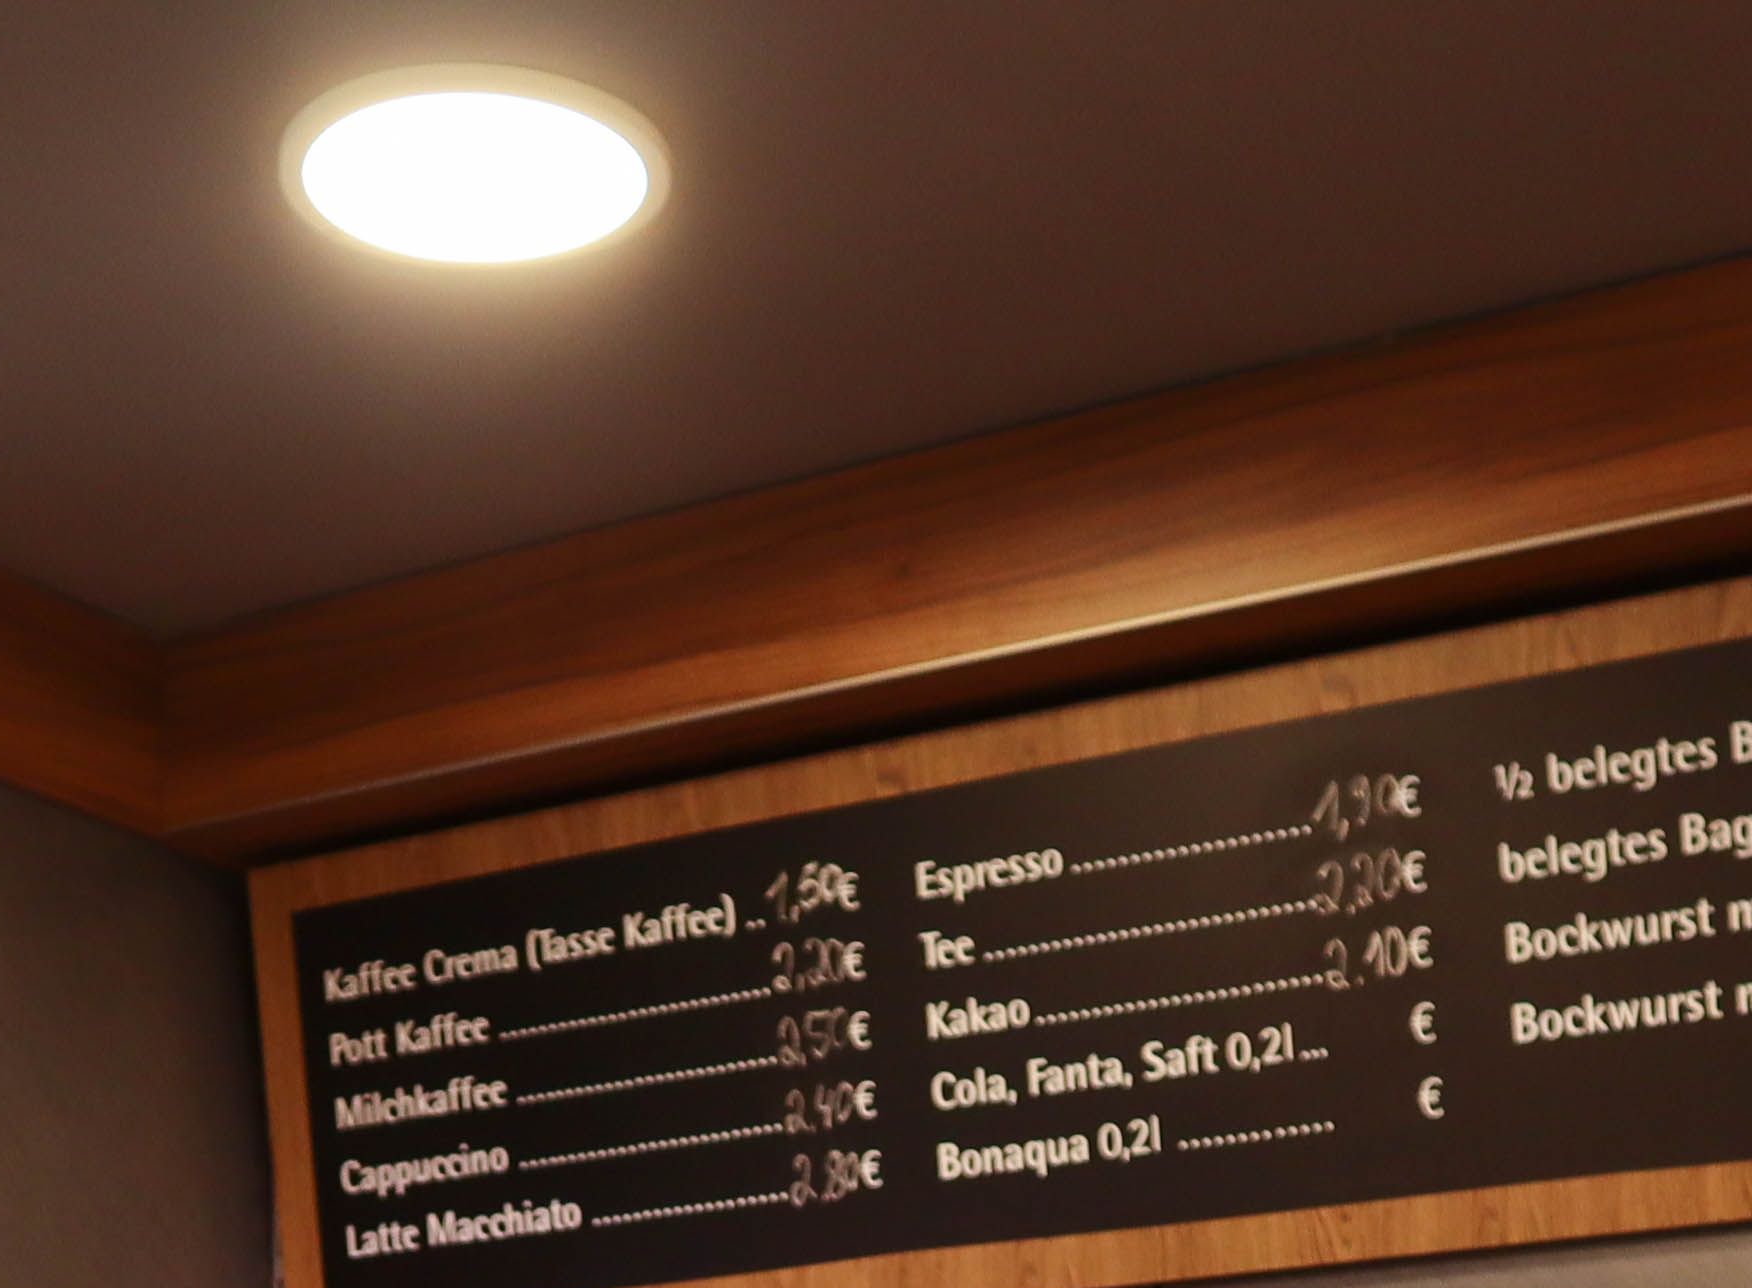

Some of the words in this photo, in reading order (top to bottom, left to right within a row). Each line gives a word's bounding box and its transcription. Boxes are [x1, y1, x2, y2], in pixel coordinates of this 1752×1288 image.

[1546, 731, 1718, 794] belegtes
[914, 848, 1065, 904] Espresso
[1498, 823, 1668, 884] belegtes
[323, 961, 415, 1002] Kaffee
[424, 939, 518, 982] Crema
[526, 925, 614, 969] (Tasse
[623, 892, 736, 956] Kaffee)
[918, 929, 977, 970] Tee
[1505, 895, 1717, 964] Bockwurst
[329, 1032, 390, 1066] Pott
[395, 1012, 491, 1055] Kaffee
[925, 996, 1031, 1041] Kakao
[1511, 976, 1723, 1044] Bockwurst
[930, 1066, 1018, 1111] Cola,
[1026, 1054, 1133, 1099] Fanta,
[1141, 1034, 1220, 1082] Saft
[1408, 1001, 1438, 1045] €
[335, 1077, 508, 1131] Milchkaffee
[936, 1130, 1090, 1181] Bonaqua
[1416, 1075, 1445, 1120] €
[340, 1144, 510, 1199] Cappuccino
[346, 1221, 420, 1259] Latte
[427, 1198, 582, 1249] Macchiato
